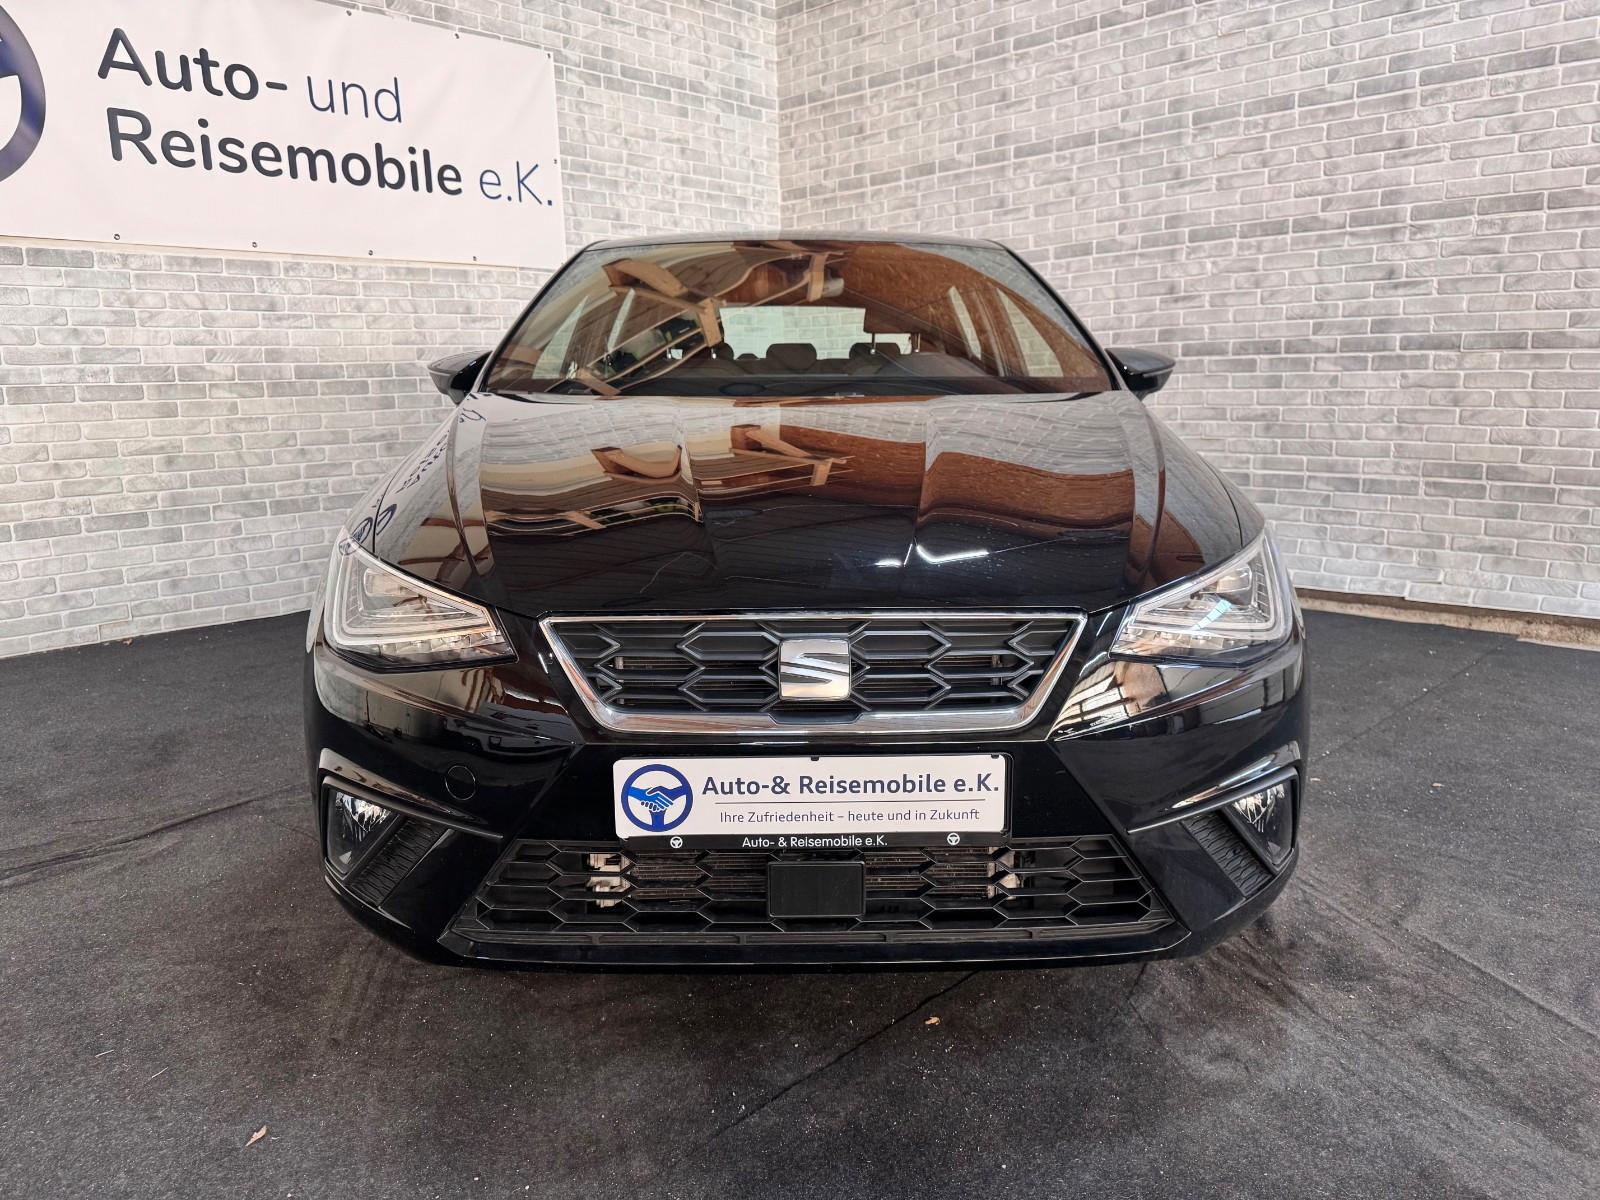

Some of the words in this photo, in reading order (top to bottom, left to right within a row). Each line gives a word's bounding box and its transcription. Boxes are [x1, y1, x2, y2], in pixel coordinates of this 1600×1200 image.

[98, 27, 288, 101] Auto-
[306, 75, 403, 124] und
[106, 106, 463, 196] Reisemobile
[479, 160, 553, 207] e.K.
[702, 775, 791, 795] Auto-&
[799, 773, 946, 794] Reisemobile
[953, 772, 999, 793] e.K.
[720, 811, 745, 823] Ihre
[747, 811, 835, 823] Zufriedenheit
[848, 810, 884, 821] heute
[887, 810, 911, 821] und
[915, 810, 926, 821] in
[929, 808, 980, 820] Zukunft
[742, 836, 775, 848] Auto-
[777, 836, 788, 848] &
[790, 835, 863, 848] Reisemobile
[864, 834, 888, 847] e.K.
